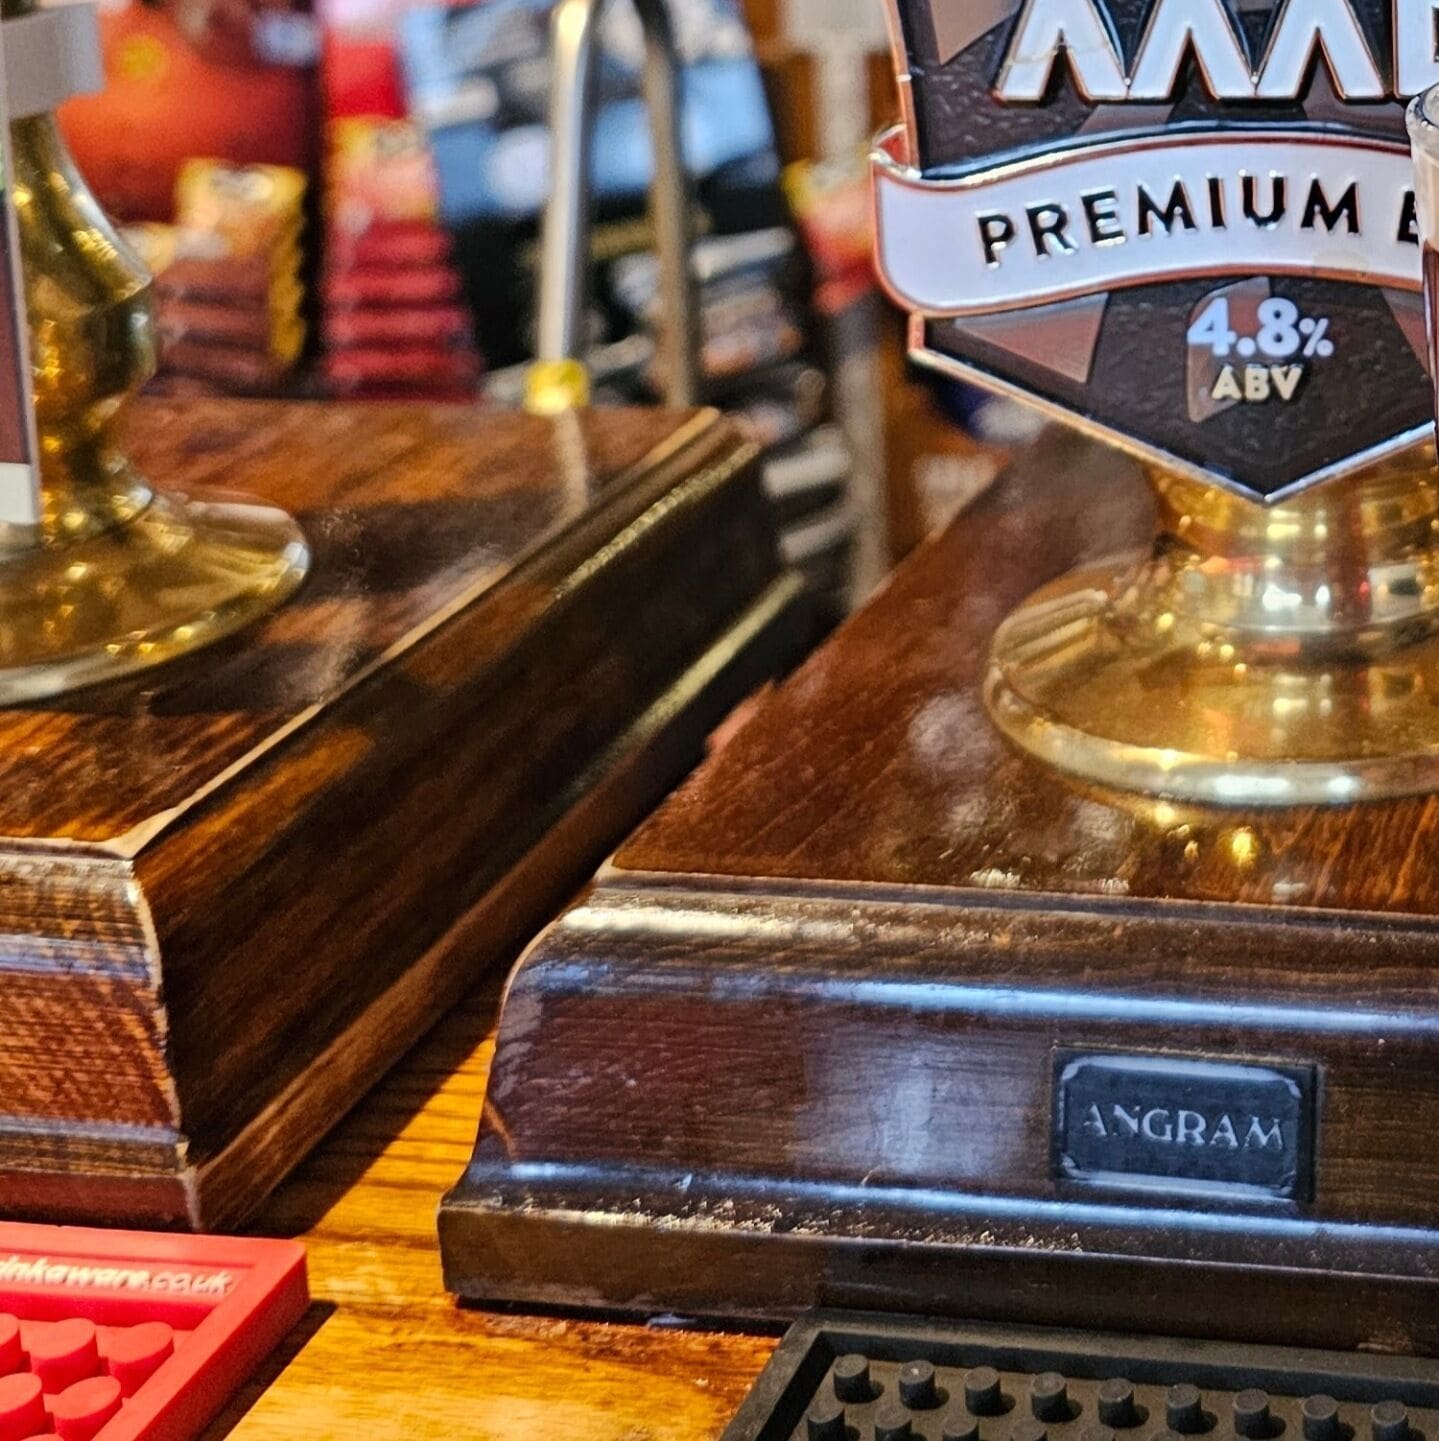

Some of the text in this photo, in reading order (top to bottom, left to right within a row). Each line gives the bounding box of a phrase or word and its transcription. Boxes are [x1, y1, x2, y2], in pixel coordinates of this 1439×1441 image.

[977, 172, 1362, 268] PREMIUM
[1187, 296, 1335, 358] 4.8%
[1210, 364, 1303, 402] ABV
[1083, 1103, 1283, 1150] ANGRAM
